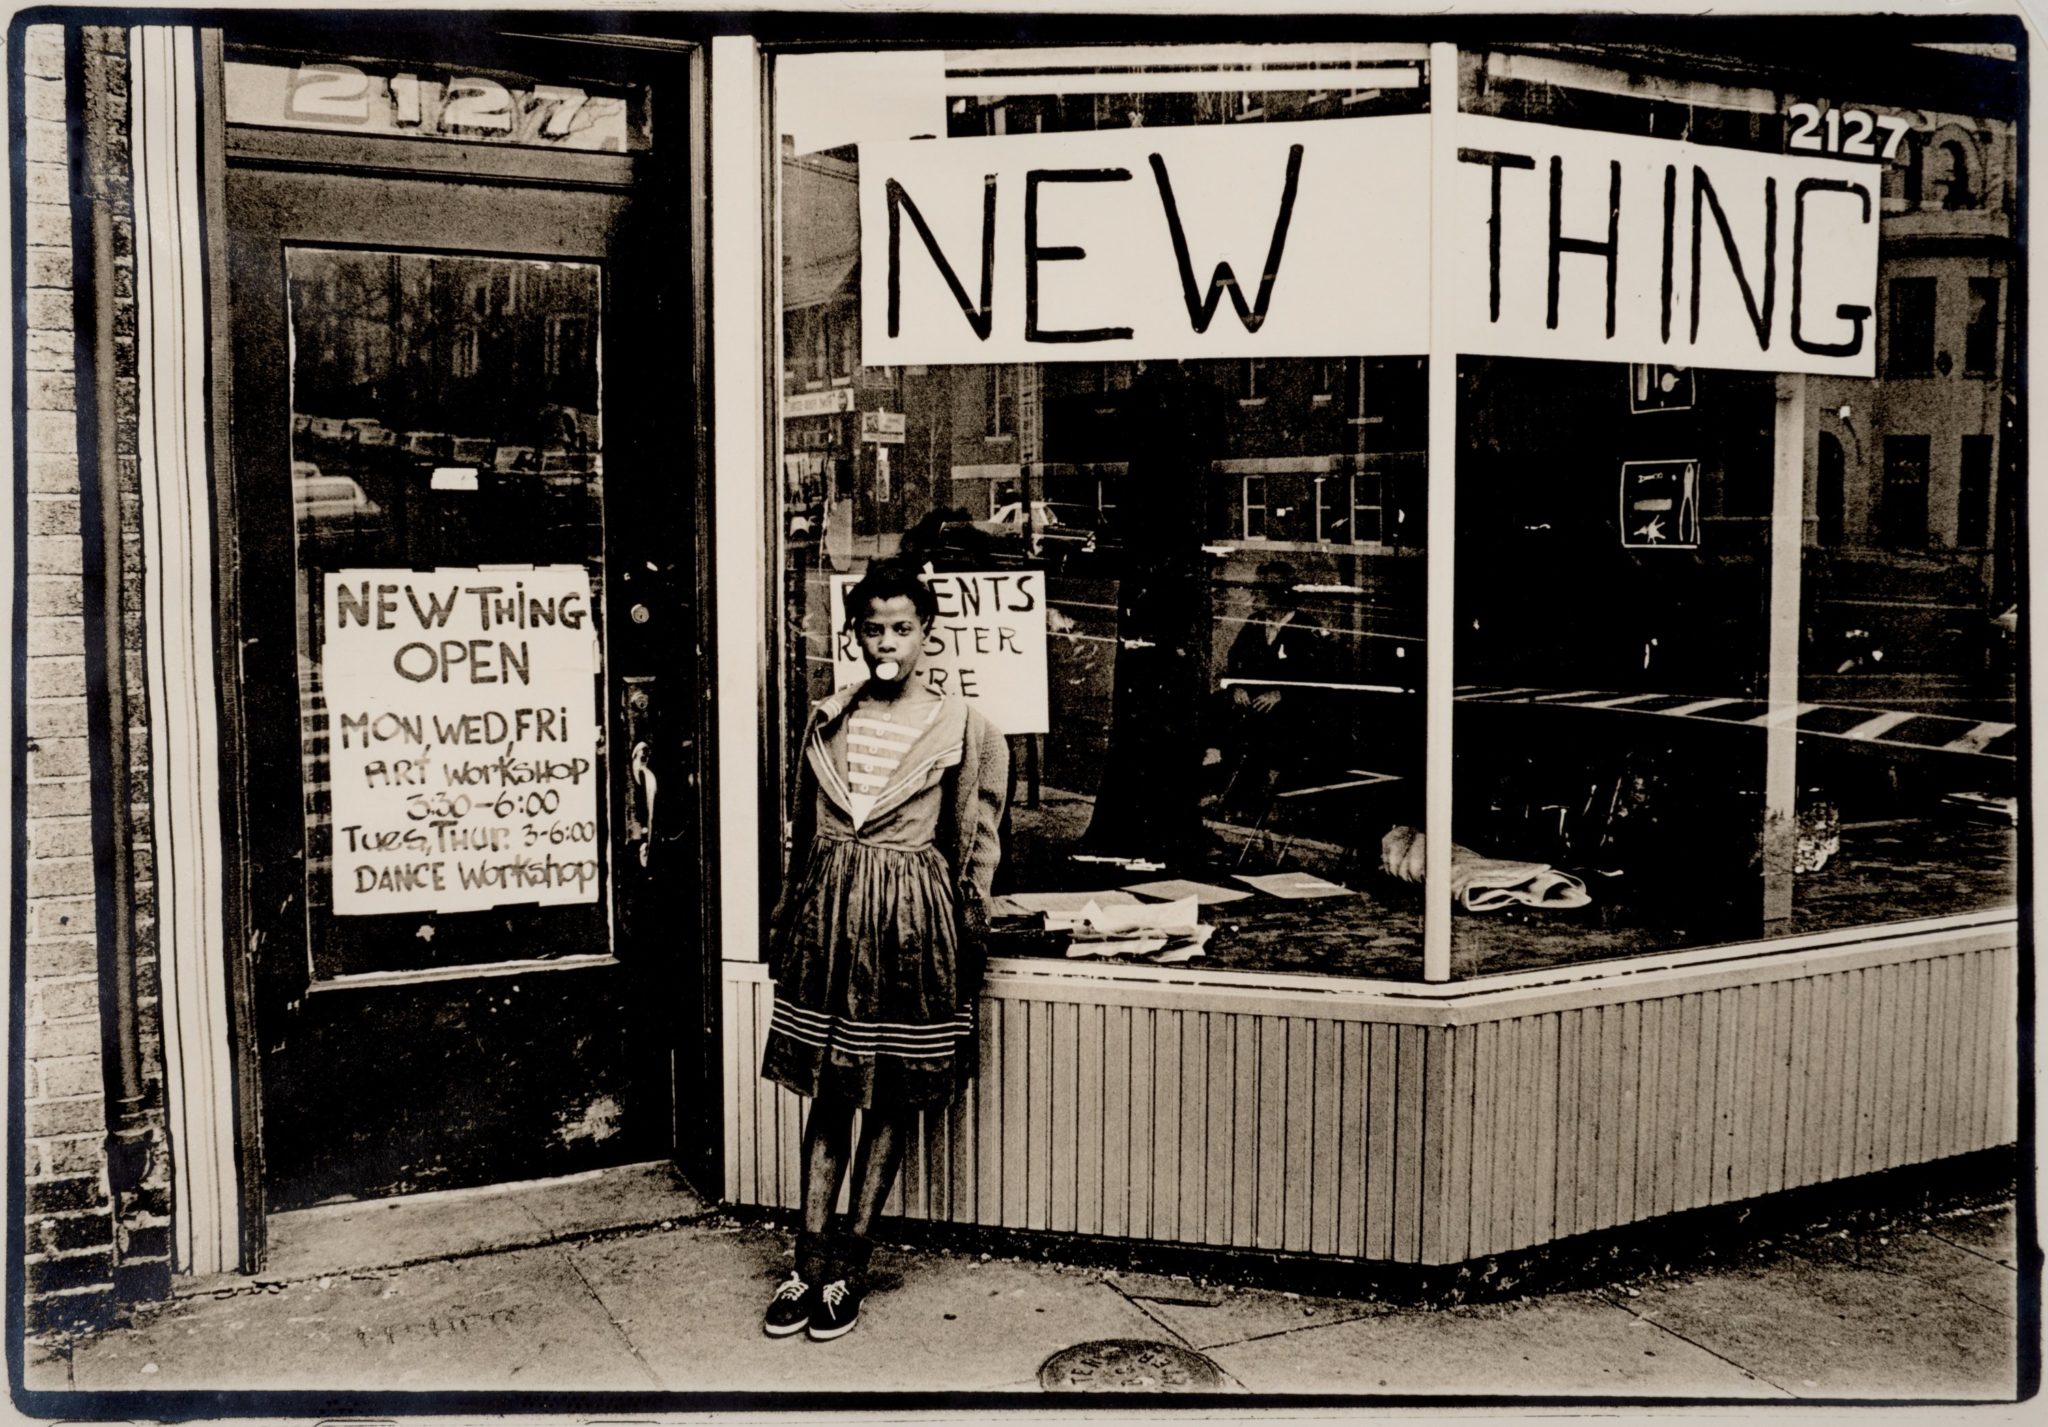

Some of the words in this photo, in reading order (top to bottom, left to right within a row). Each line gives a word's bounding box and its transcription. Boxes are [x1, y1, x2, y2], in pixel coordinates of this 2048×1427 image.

[286, 64, 589, 137] 2127
[1788, 102, 1910, 160] 2127
[885, 143, 1305, 343] NEW
[1457, 147, 1873, 358] THING
[337, 580, 459, 630] NEW
[394, 639, 530, 686] OPEN
[837, 625, 1024, 662] RSTER
[354, 861, 446, 894] DANCE
